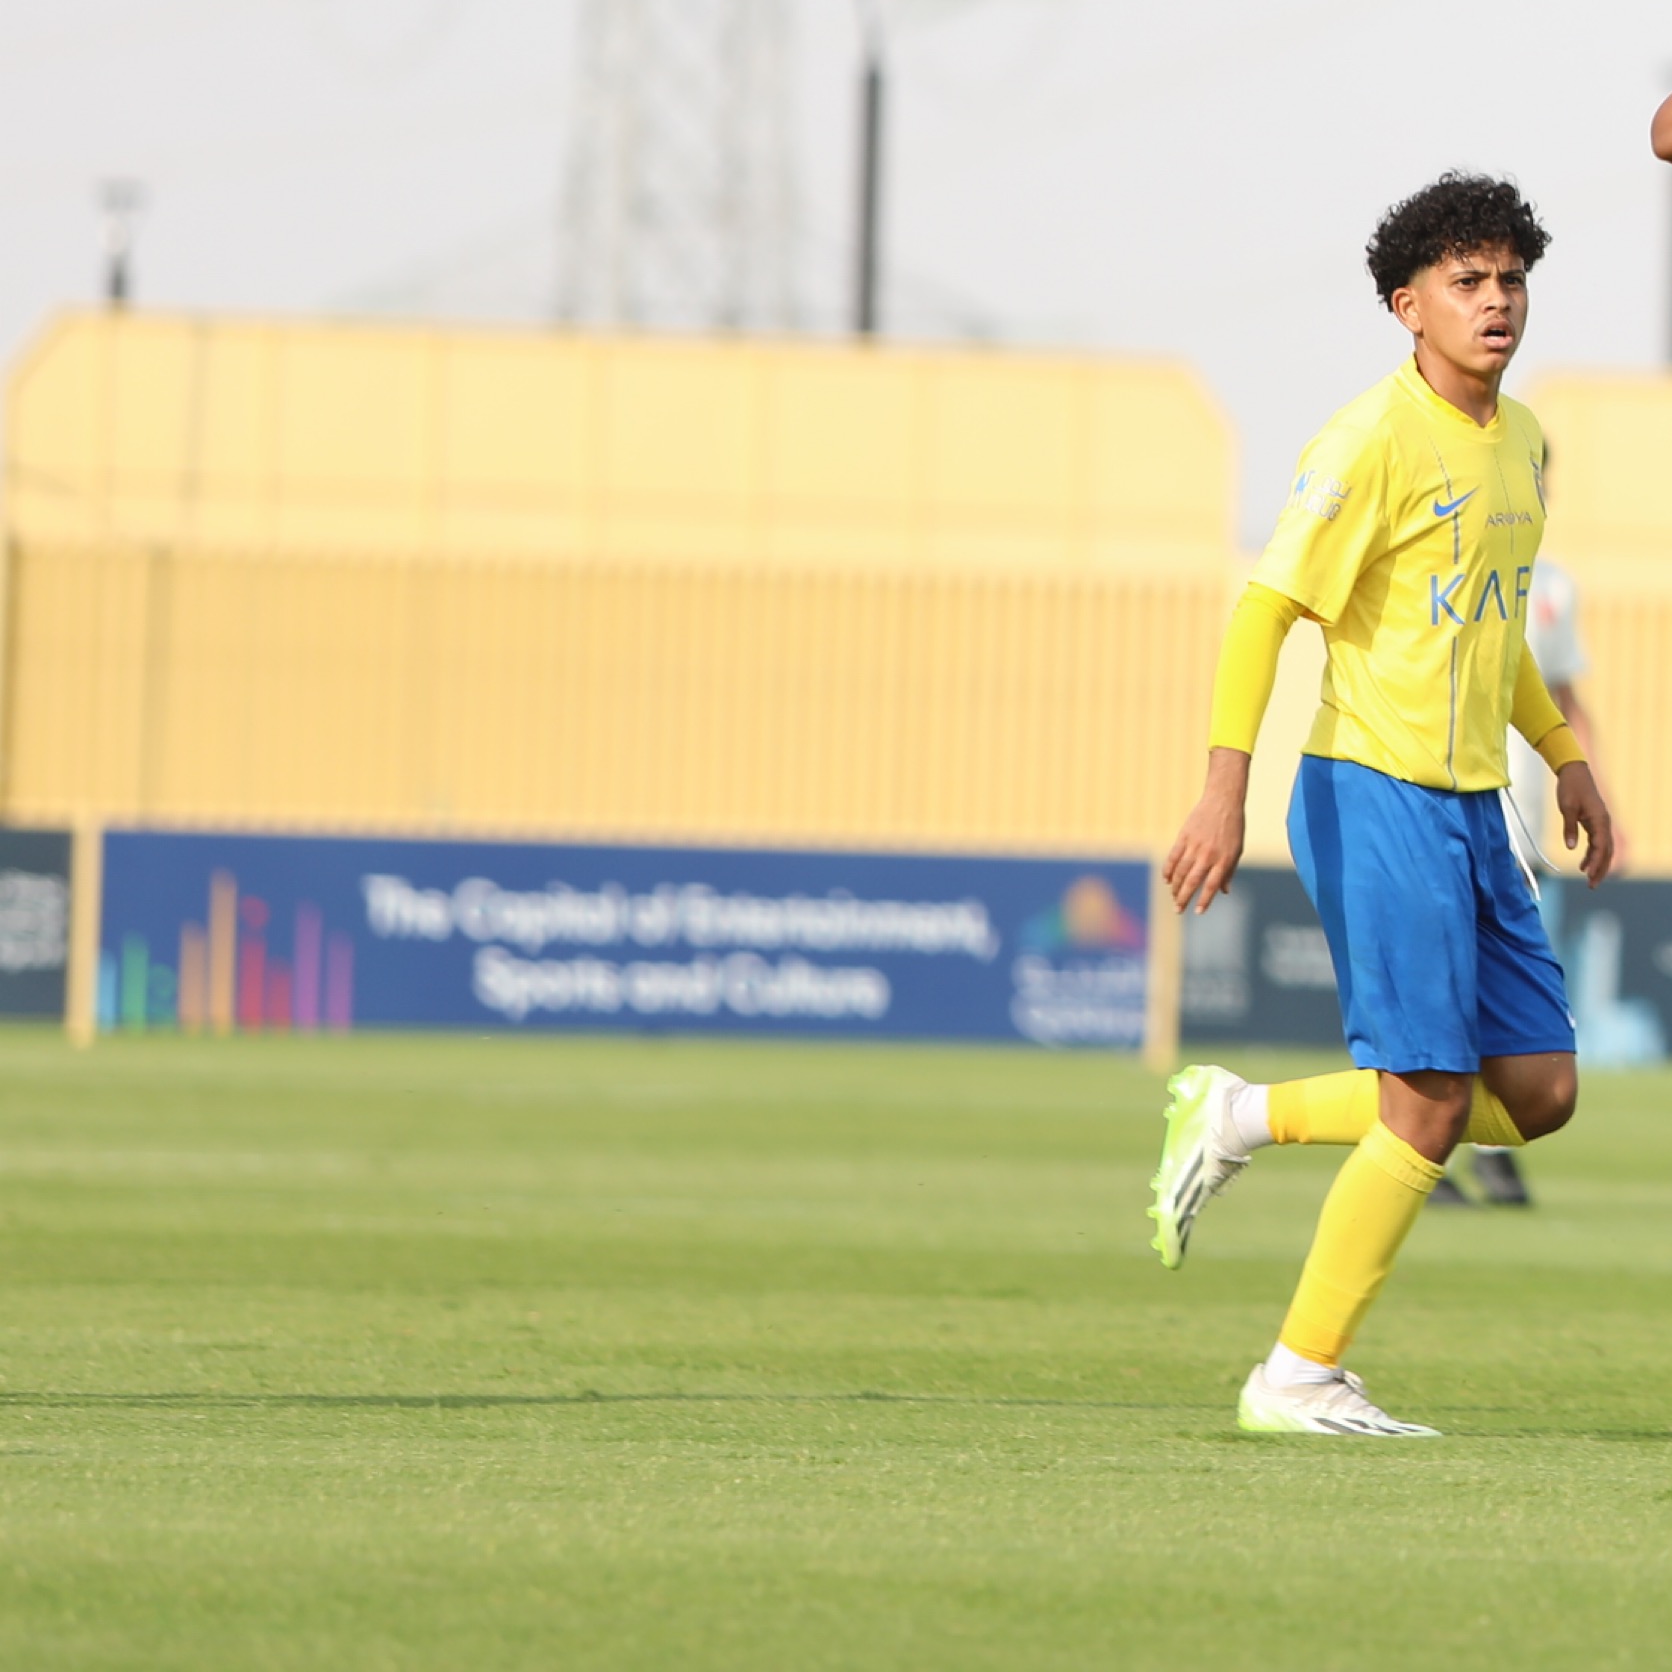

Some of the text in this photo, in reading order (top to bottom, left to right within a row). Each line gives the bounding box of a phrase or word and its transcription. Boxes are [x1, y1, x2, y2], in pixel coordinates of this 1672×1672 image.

[1430, 566, 1530, 626] KAF
[364, 875, 451, 940] The
[629, 881, 680, 947] of
[472, 945, 622, 1021] Sports
[624, 954, 720, 1014] and
